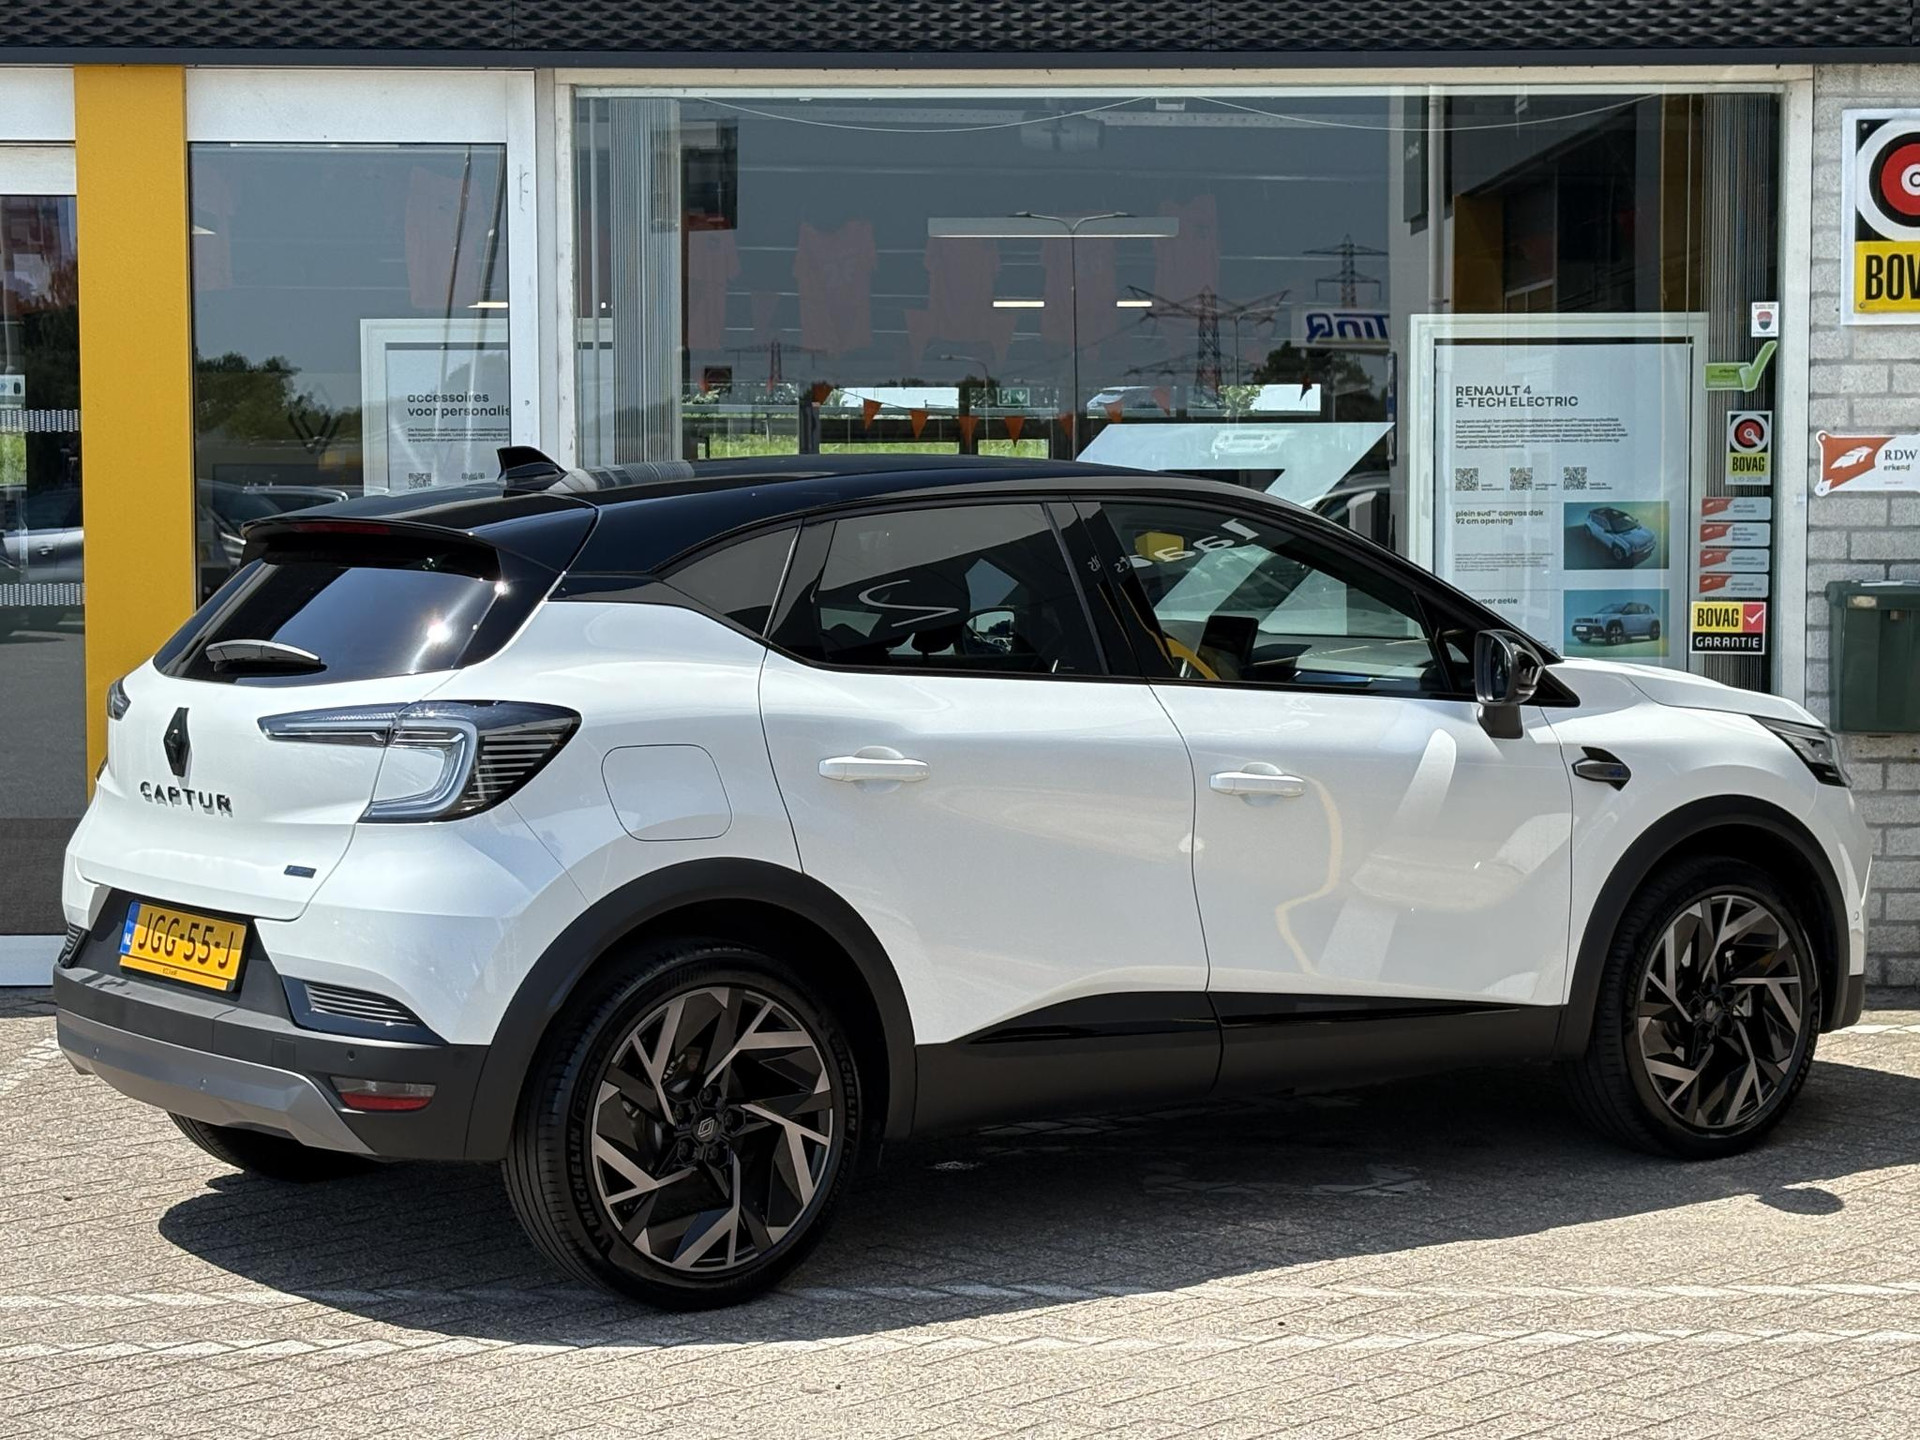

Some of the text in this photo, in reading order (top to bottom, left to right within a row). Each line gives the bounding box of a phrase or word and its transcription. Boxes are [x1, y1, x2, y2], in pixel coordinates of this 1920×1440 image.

[1455, 385, 1531, 396] RENAULT 4
[407, 392, 489, 403] accessoires
[1455, 396, 1578, 407] E-TECH ELECTRIC
[407, 408, 437, 417] voor
[1884, 449, 1918, 461] RDW
[1732, 456, 1765, 472] BOVAG
[1455, 509, 1475, 518] plein
[1528, 508, 1543, 516] dak
[1480, 517, 1513, 526] opening
[1697, 608, 1739, 628] BOVAG
[1695, 637, 1760, 649] GARANTIE
[140, 781, 233, 813] CAPTUR
[137, 912, 234, 970] JGG-55-J
